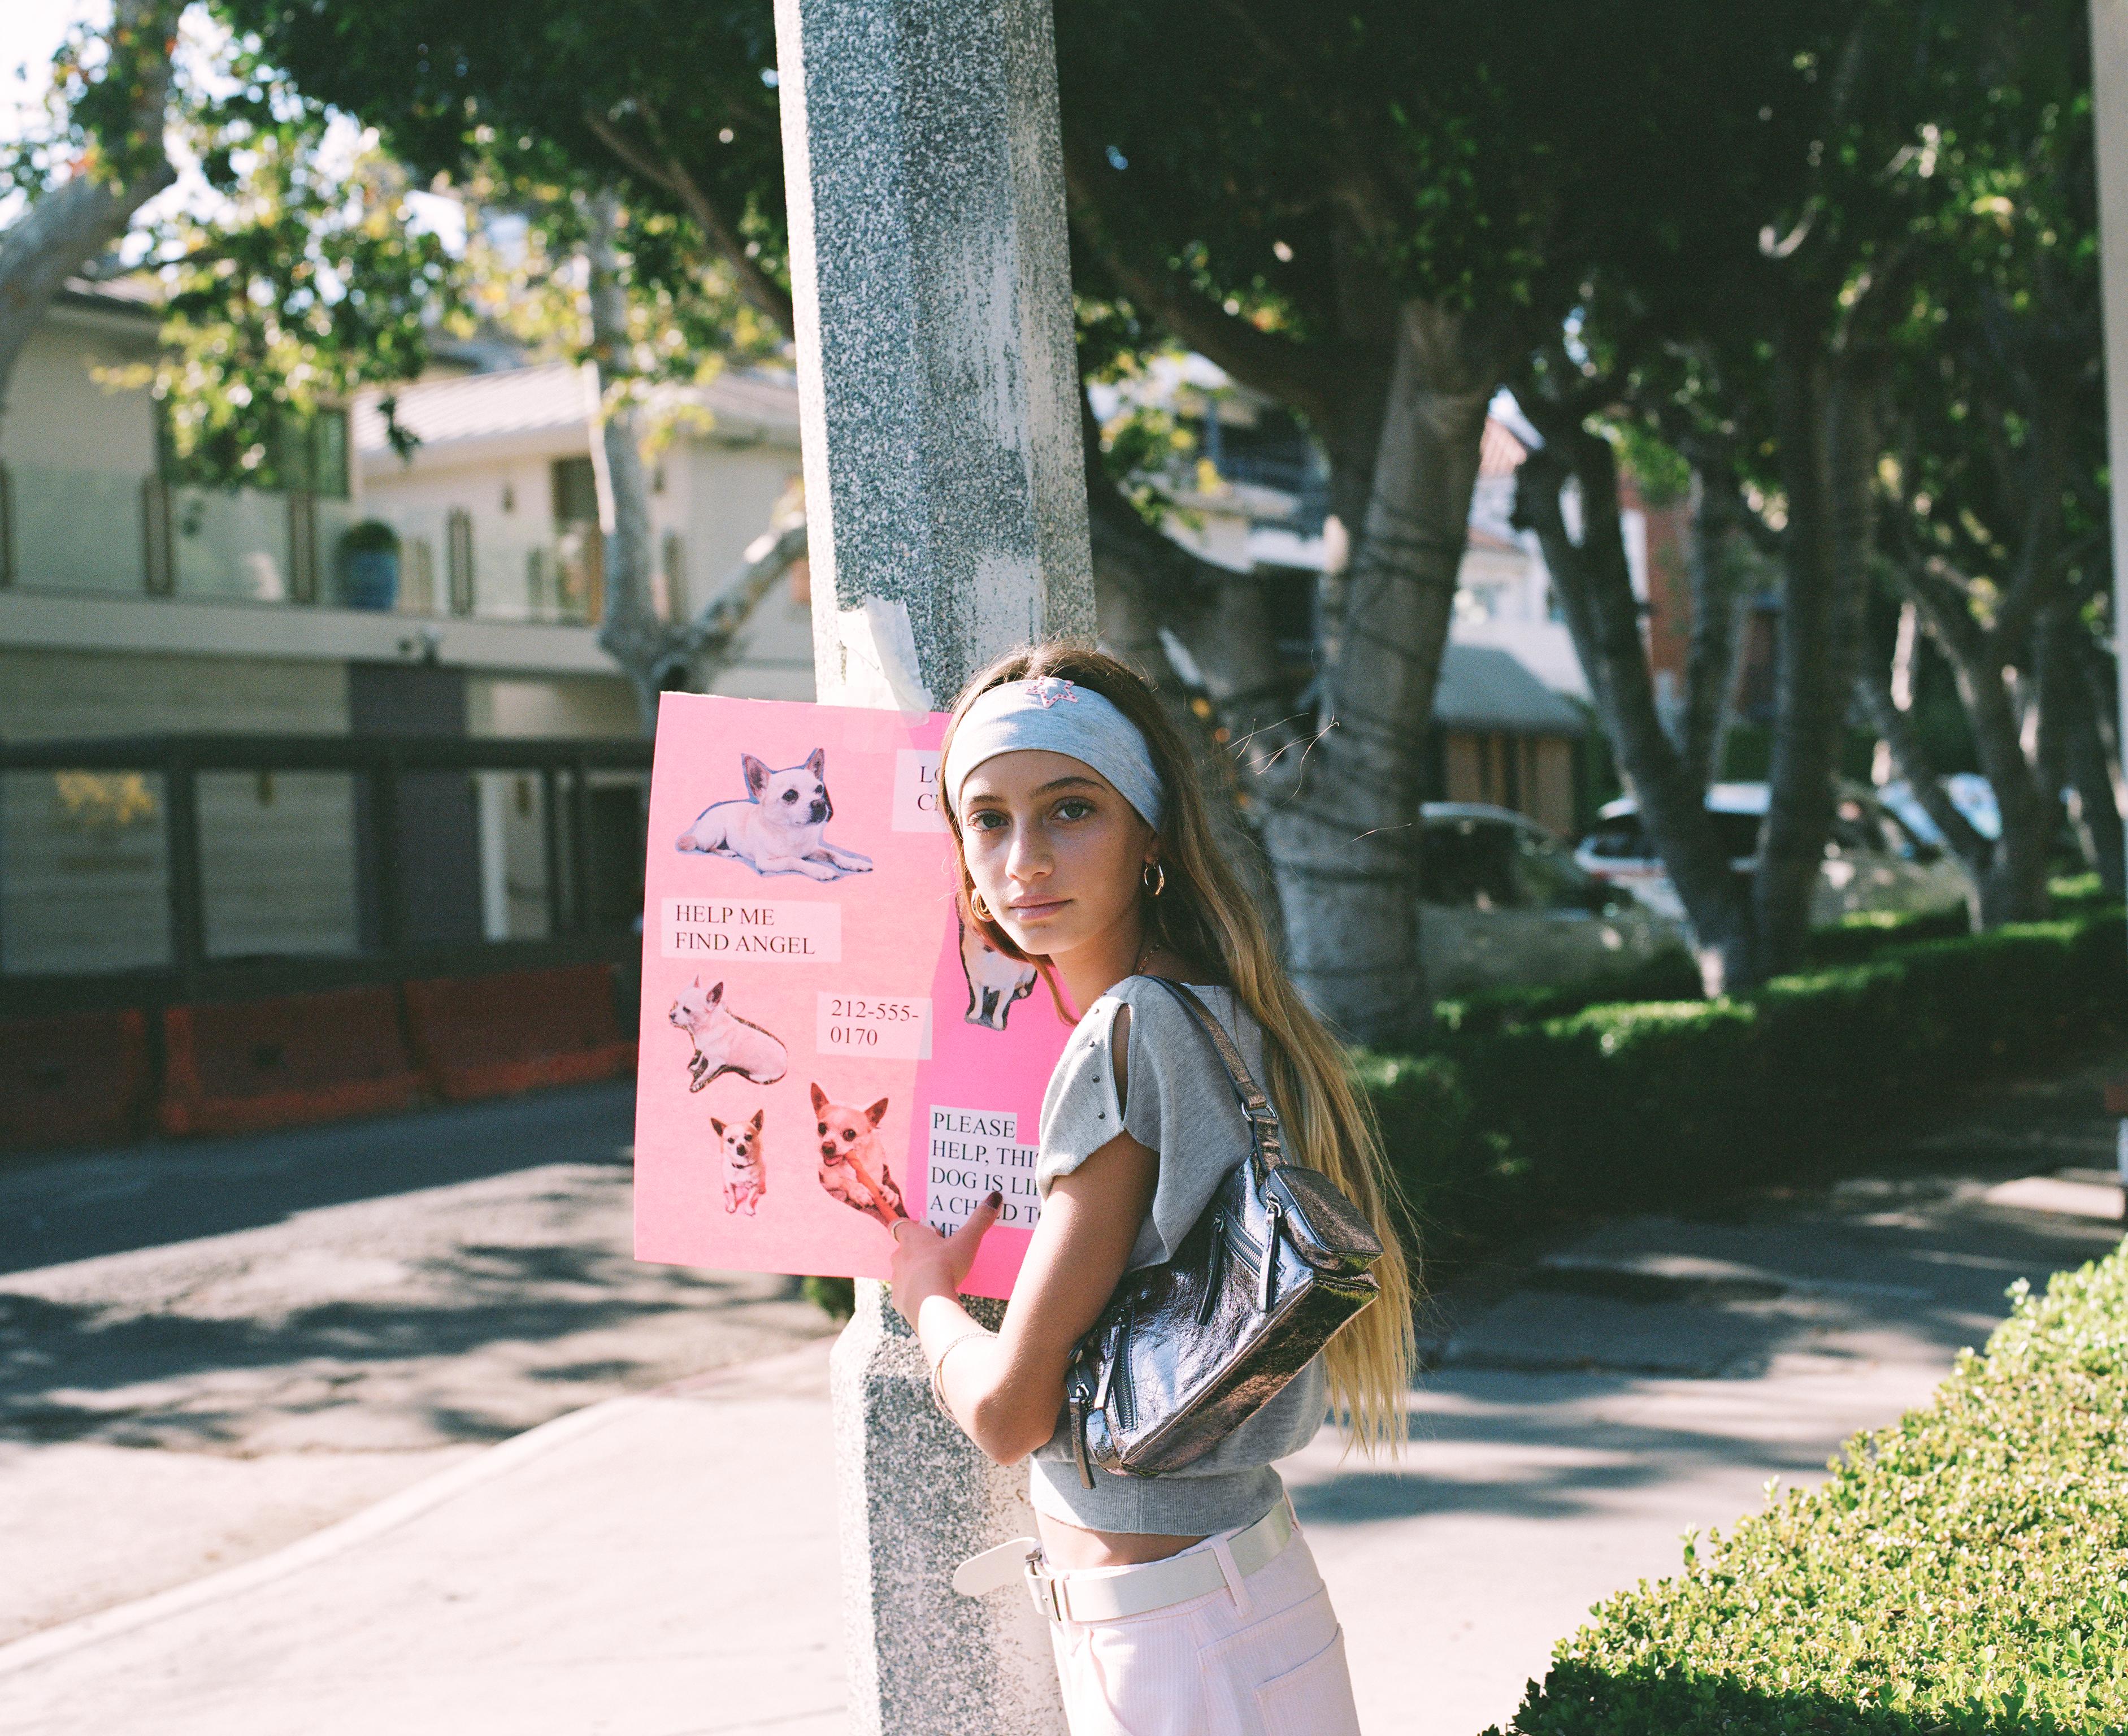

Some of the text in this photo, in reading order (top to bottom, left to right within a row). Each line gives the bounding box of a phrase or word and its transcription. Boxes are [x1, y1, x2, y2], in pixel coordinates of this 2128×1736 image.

[675, 904, 775, 926] HELP ME
[675, 932, 816, 955] FIND ANGEL
[831, 1000, 919, 1022] 212-555-
[831, 1026, 878, 1046] 0170
[933, 1112, 1015, 1139] PLEASE
[932, 1139, 1039, 1168] HELP, THI
[932, 1166, 977, 1190] DOG
[984, 1173, 1003, 1192] IS
[930, 1194, 1041, 1223] A CHD T
